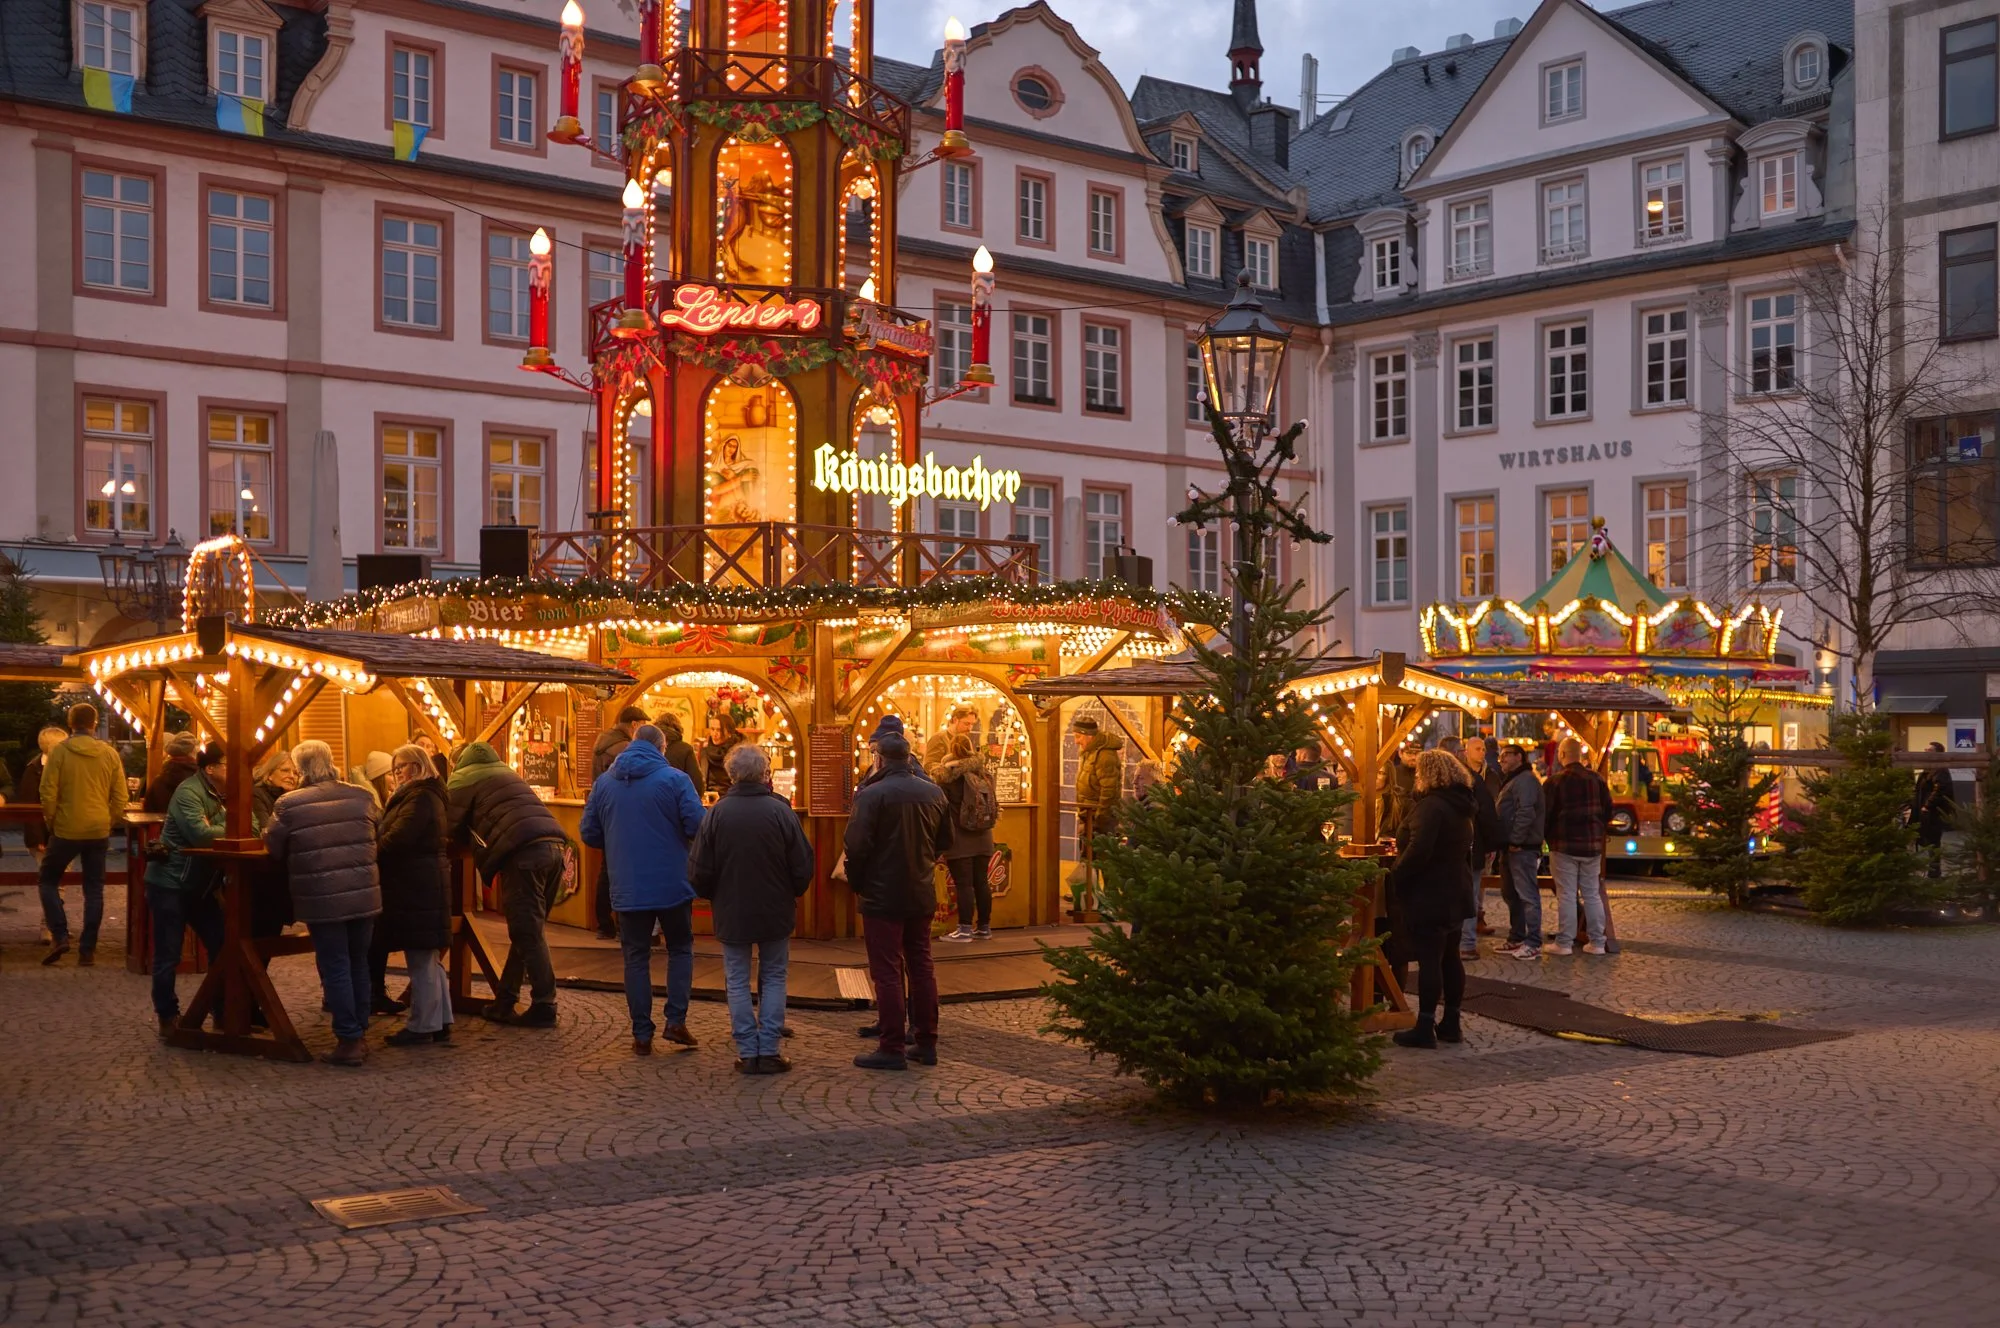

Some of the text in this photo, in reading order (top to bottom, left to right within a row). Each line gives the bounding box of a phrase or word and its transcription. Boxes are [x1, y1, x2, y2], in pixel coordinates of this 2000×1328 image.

[1498, 440, 1633, 470] WIRTSHAUS
[813, 442, 1022, 512] Königsbacher
[467, 600, 525, 622] Bier
[538, 607, 570, 621] vom
[1955, 738, 1973, 748] AXA
